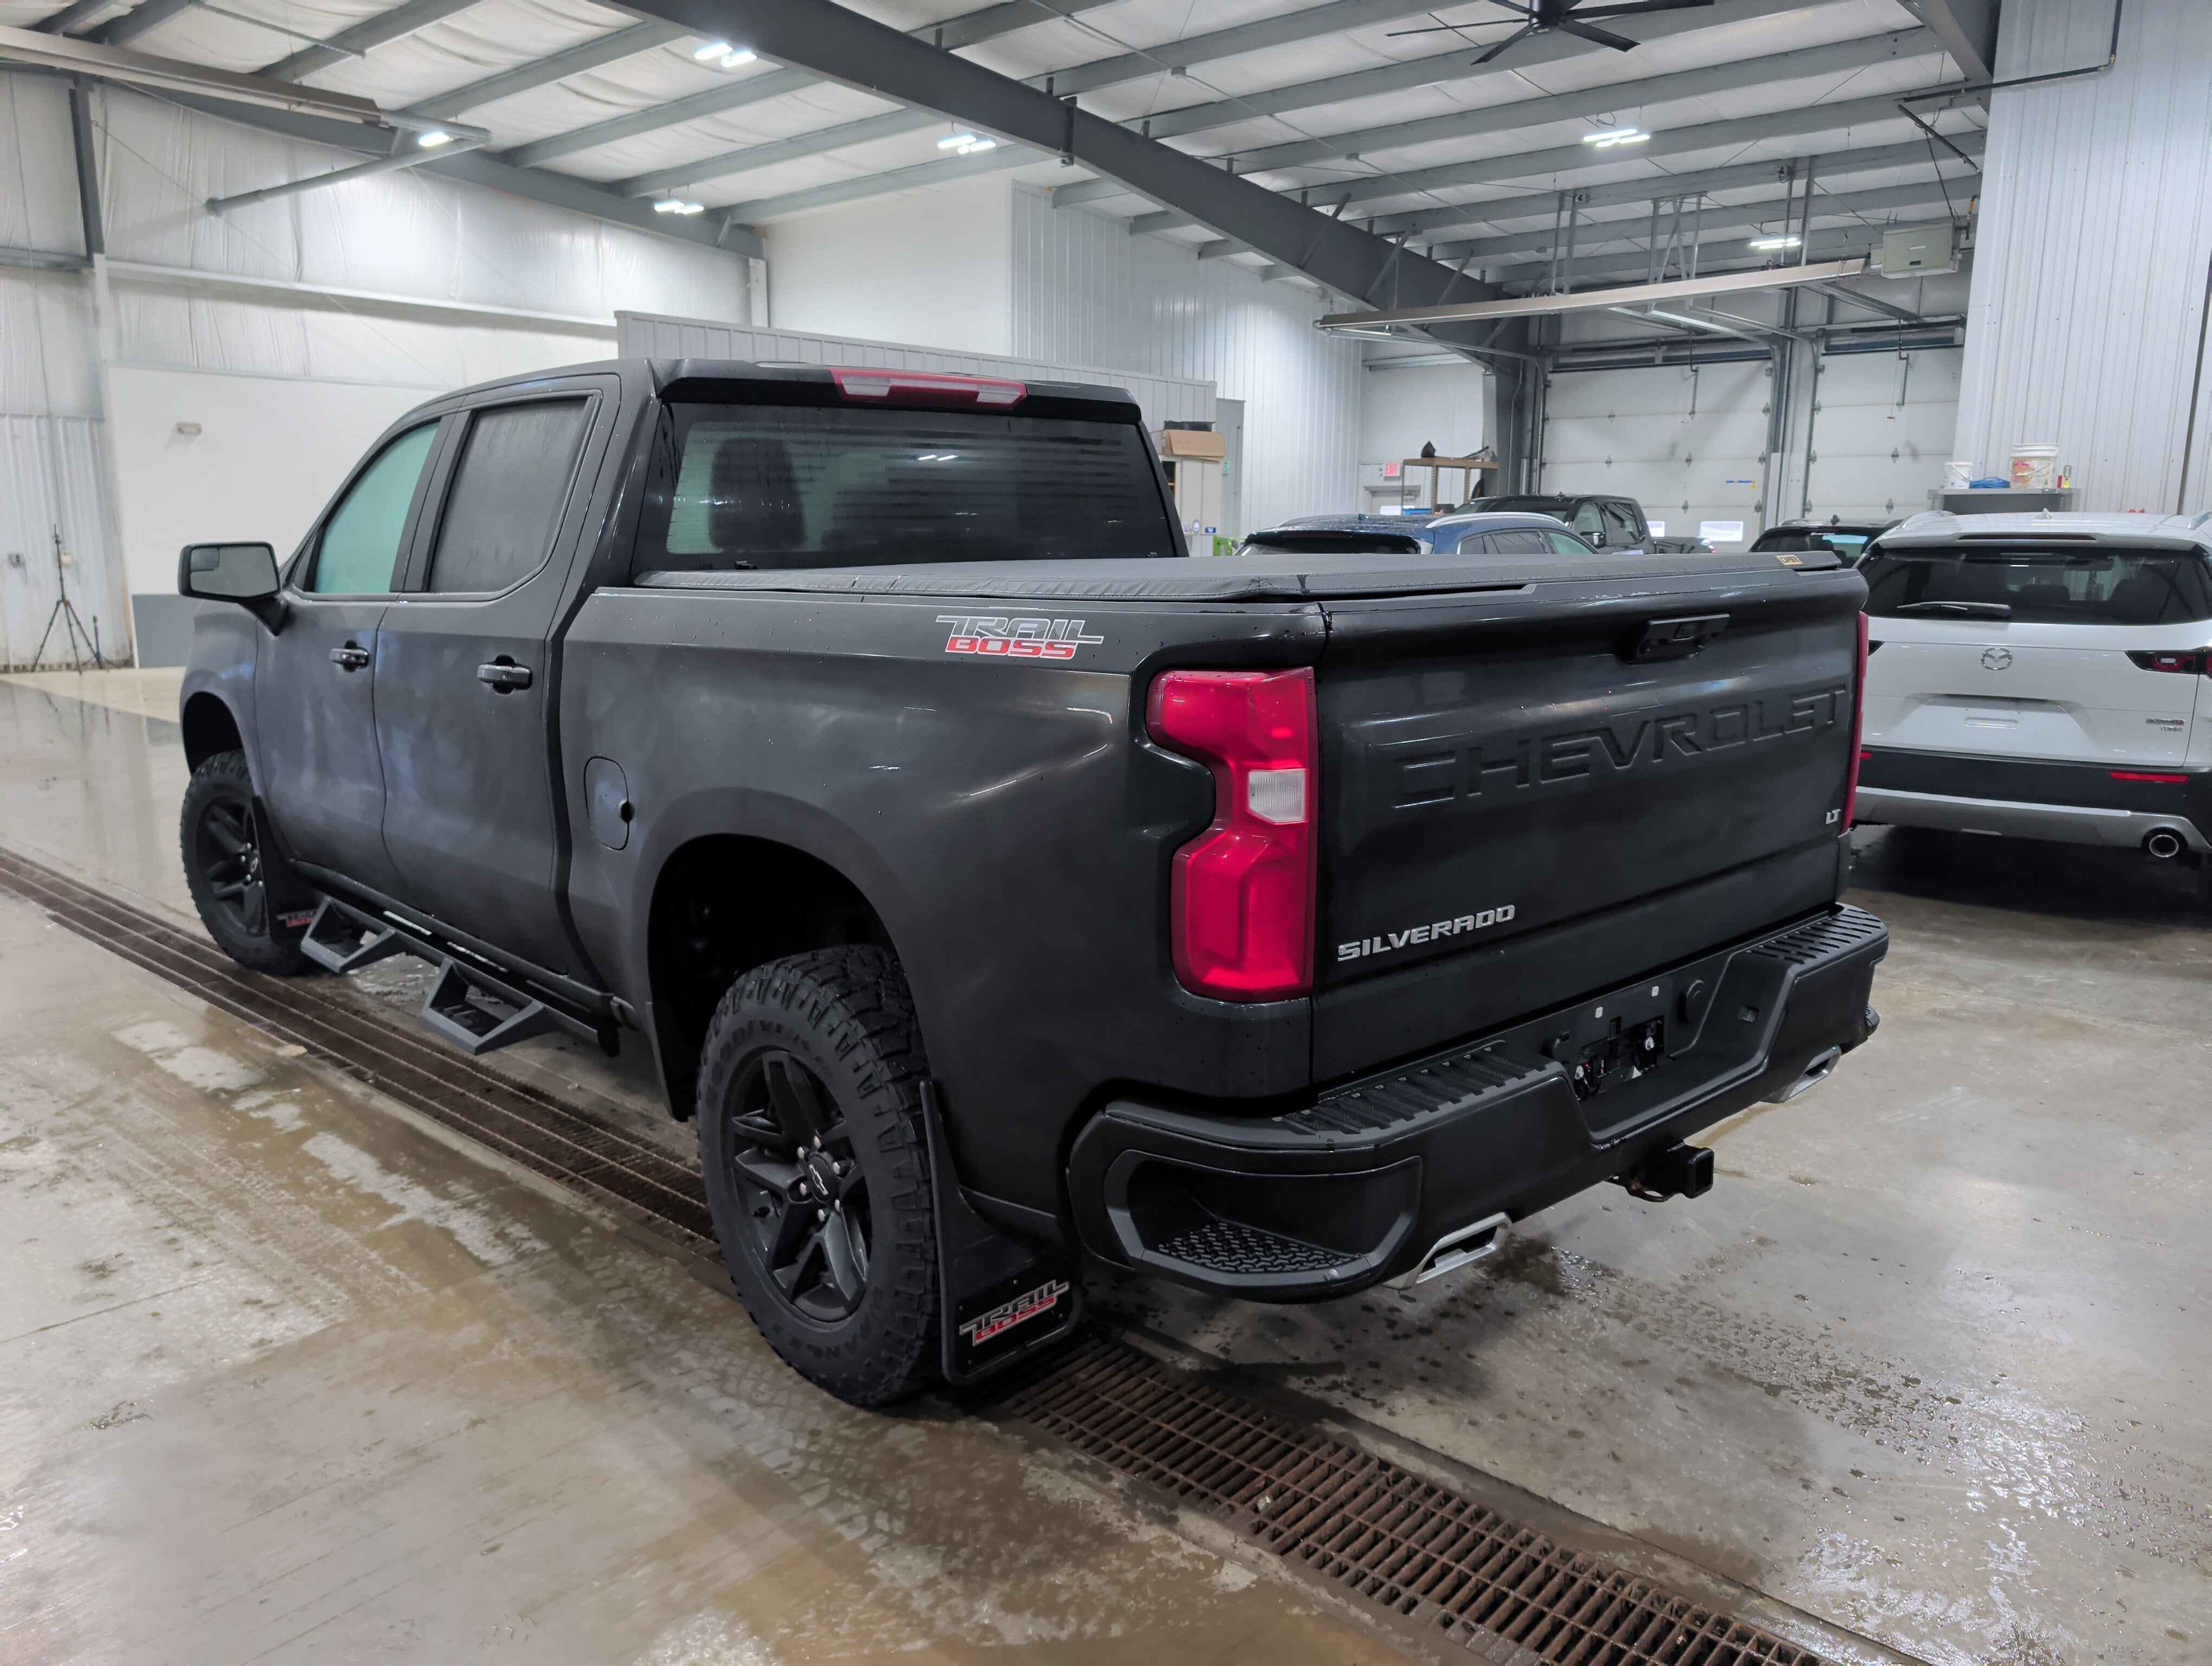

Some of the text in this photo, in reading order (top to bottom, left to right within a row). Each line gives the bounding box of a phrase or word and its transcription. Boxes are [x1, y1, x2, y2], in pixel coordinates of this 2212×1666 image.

[936, 615, 1104, 644] TRAIL
[945, 636, 1078, 660] BOSS
[1392, 684, 1846, 808] CHEVROLET
[1825, 809, 1841, 824] LT
[1338, 904, 1515, 962] SILVERADO
[959, 1279, 1070, 1335] TRAIL
[973, 1294, 1057, 1347] BOSS
